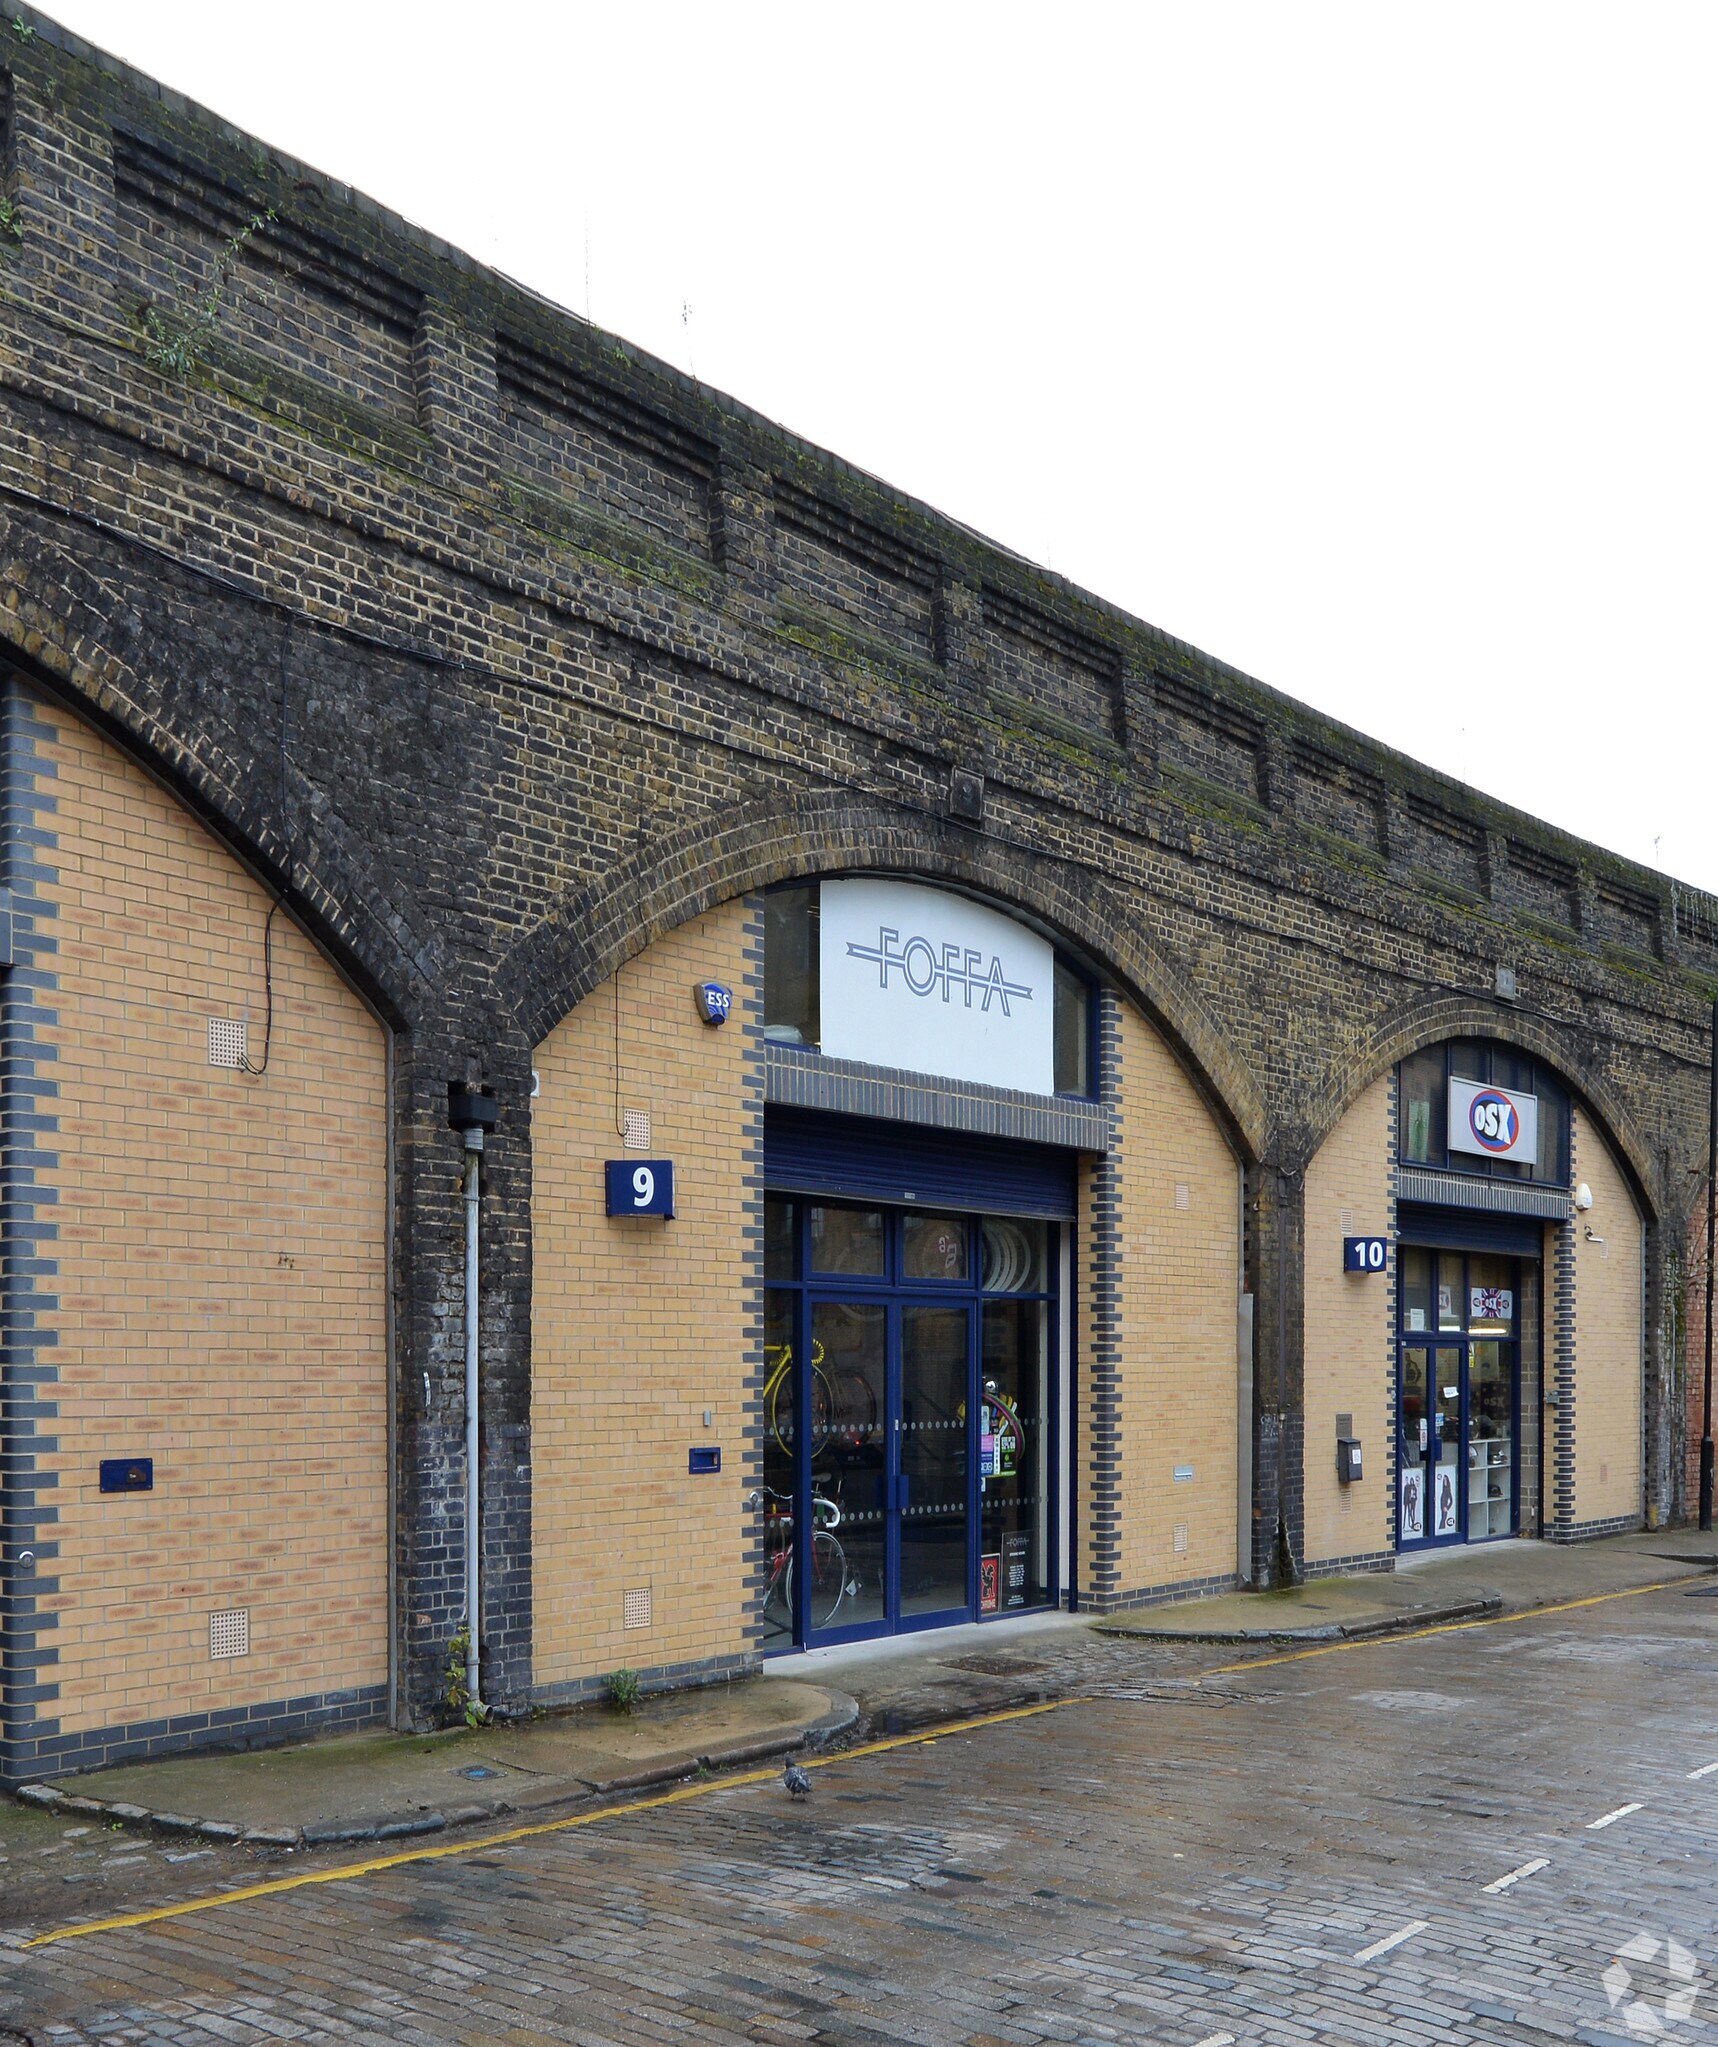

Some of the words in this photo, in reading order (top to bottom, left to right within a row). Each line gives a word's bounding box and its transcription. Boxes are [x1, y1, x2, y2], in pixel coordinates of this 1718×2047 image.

[879, 925, 1011, 1018] FOFFA
[708, 991, 730, 1008] ESS
[1474, 1102, 1512, 1146] OSX
[632, 1166, 655, 1207] 9
[1354, 1241, 1384, 1268] 10
